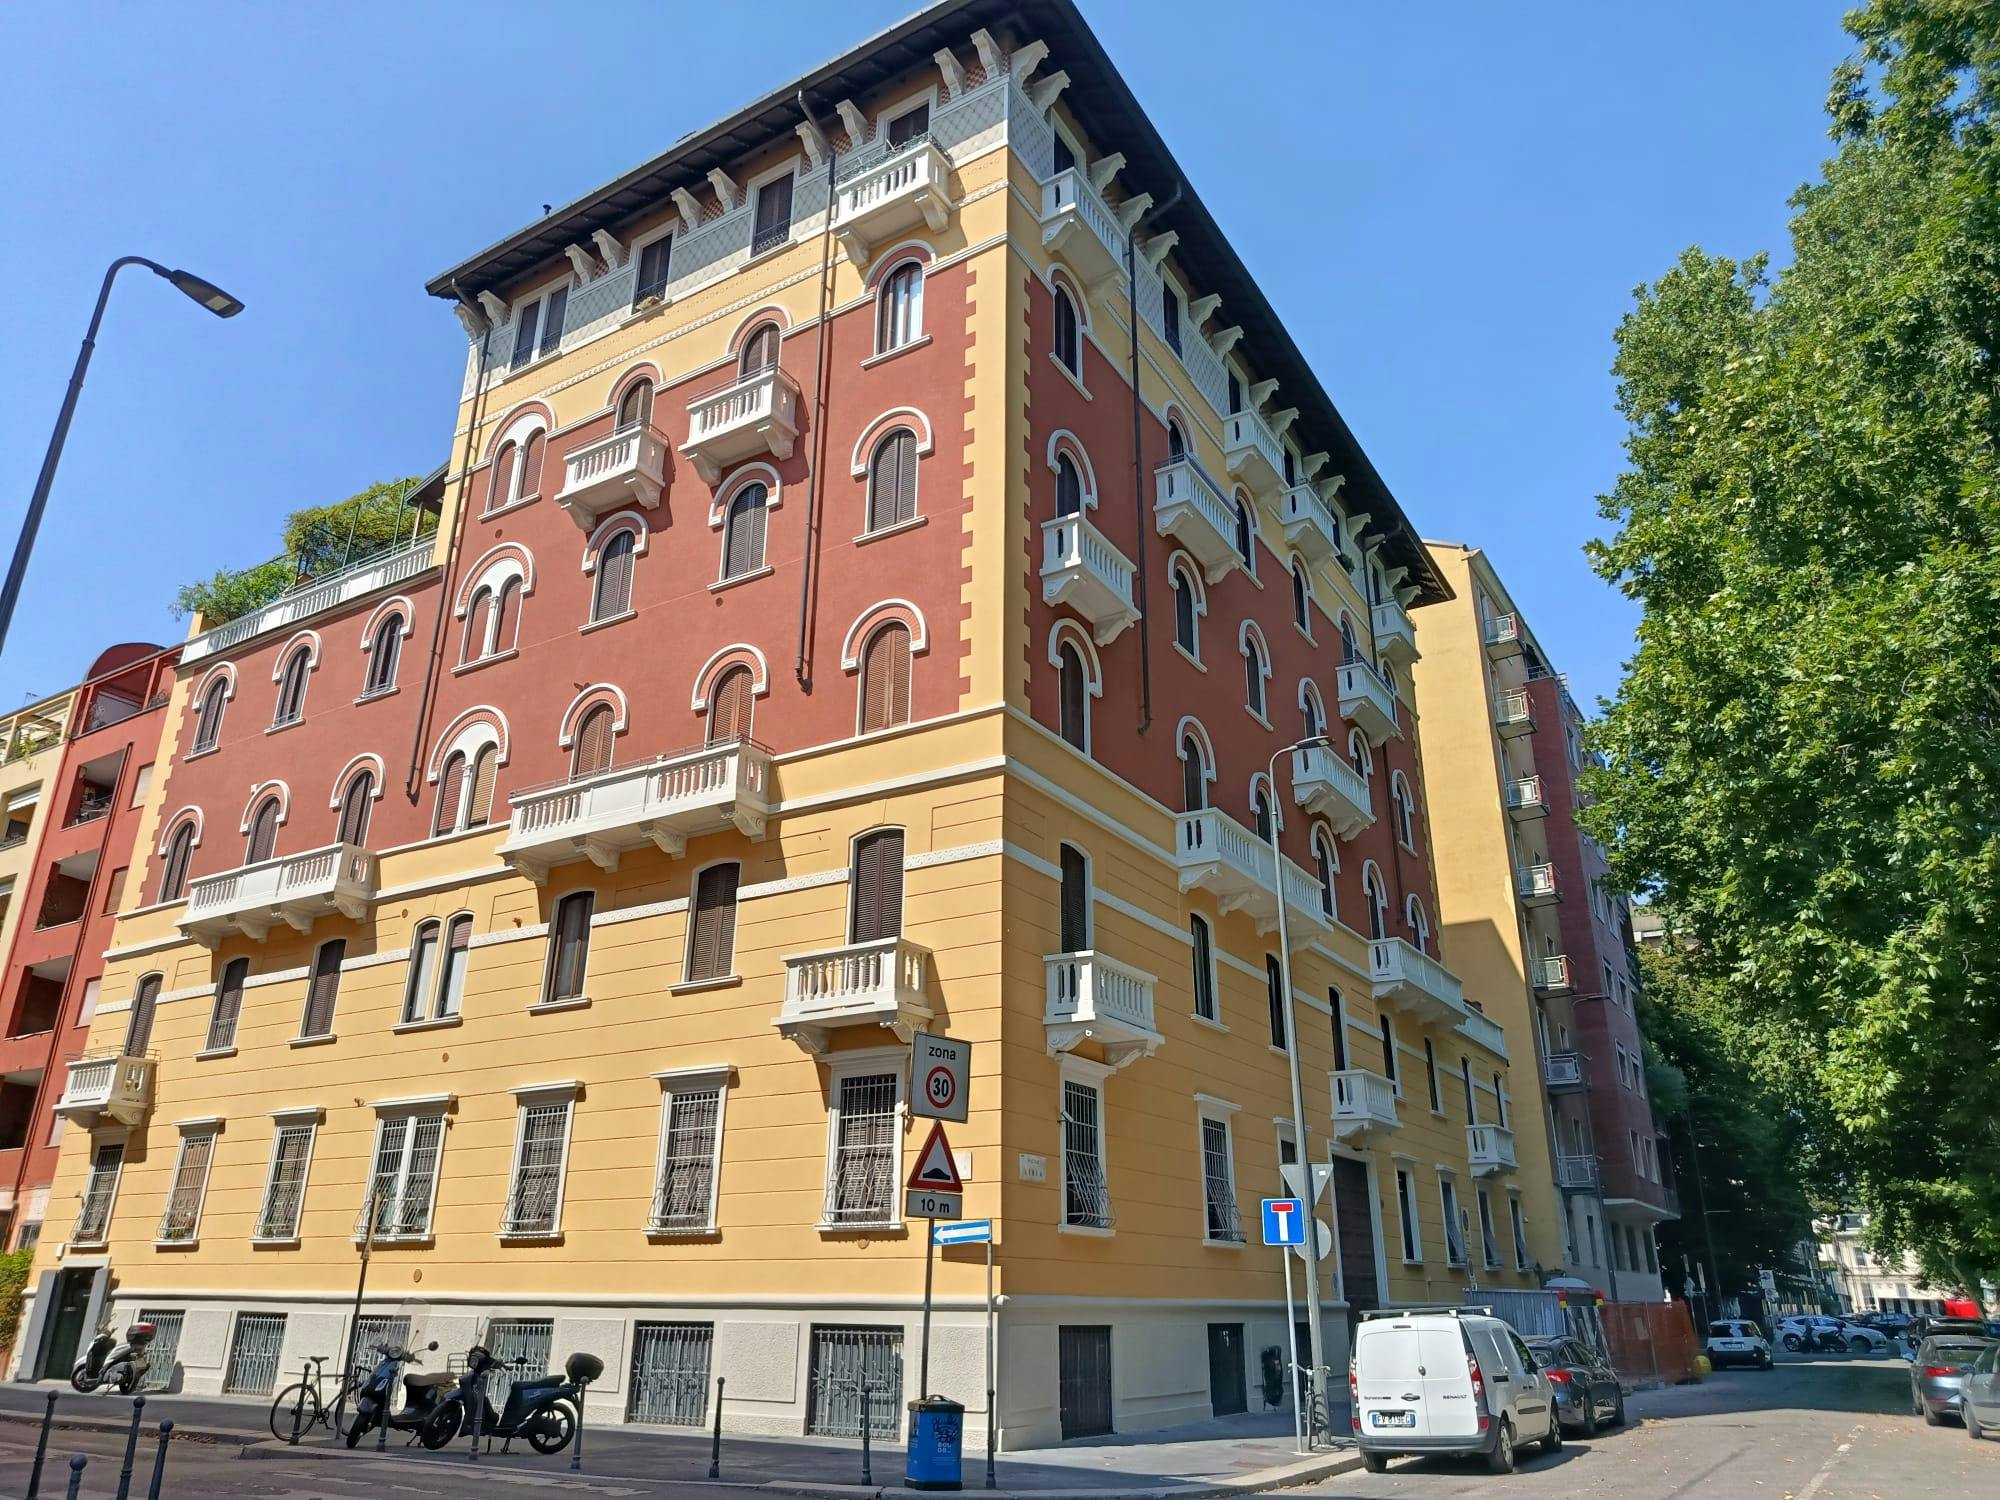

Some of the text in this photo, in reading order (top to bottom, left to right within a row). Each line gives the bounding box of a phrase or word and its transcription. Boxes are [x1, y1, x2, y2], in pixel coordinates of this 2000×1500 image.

[929, 1046, 956, 1060] zona
[933, 1077, 949, 1097] 30
[921, 1198, 950, 1213] 10 m
